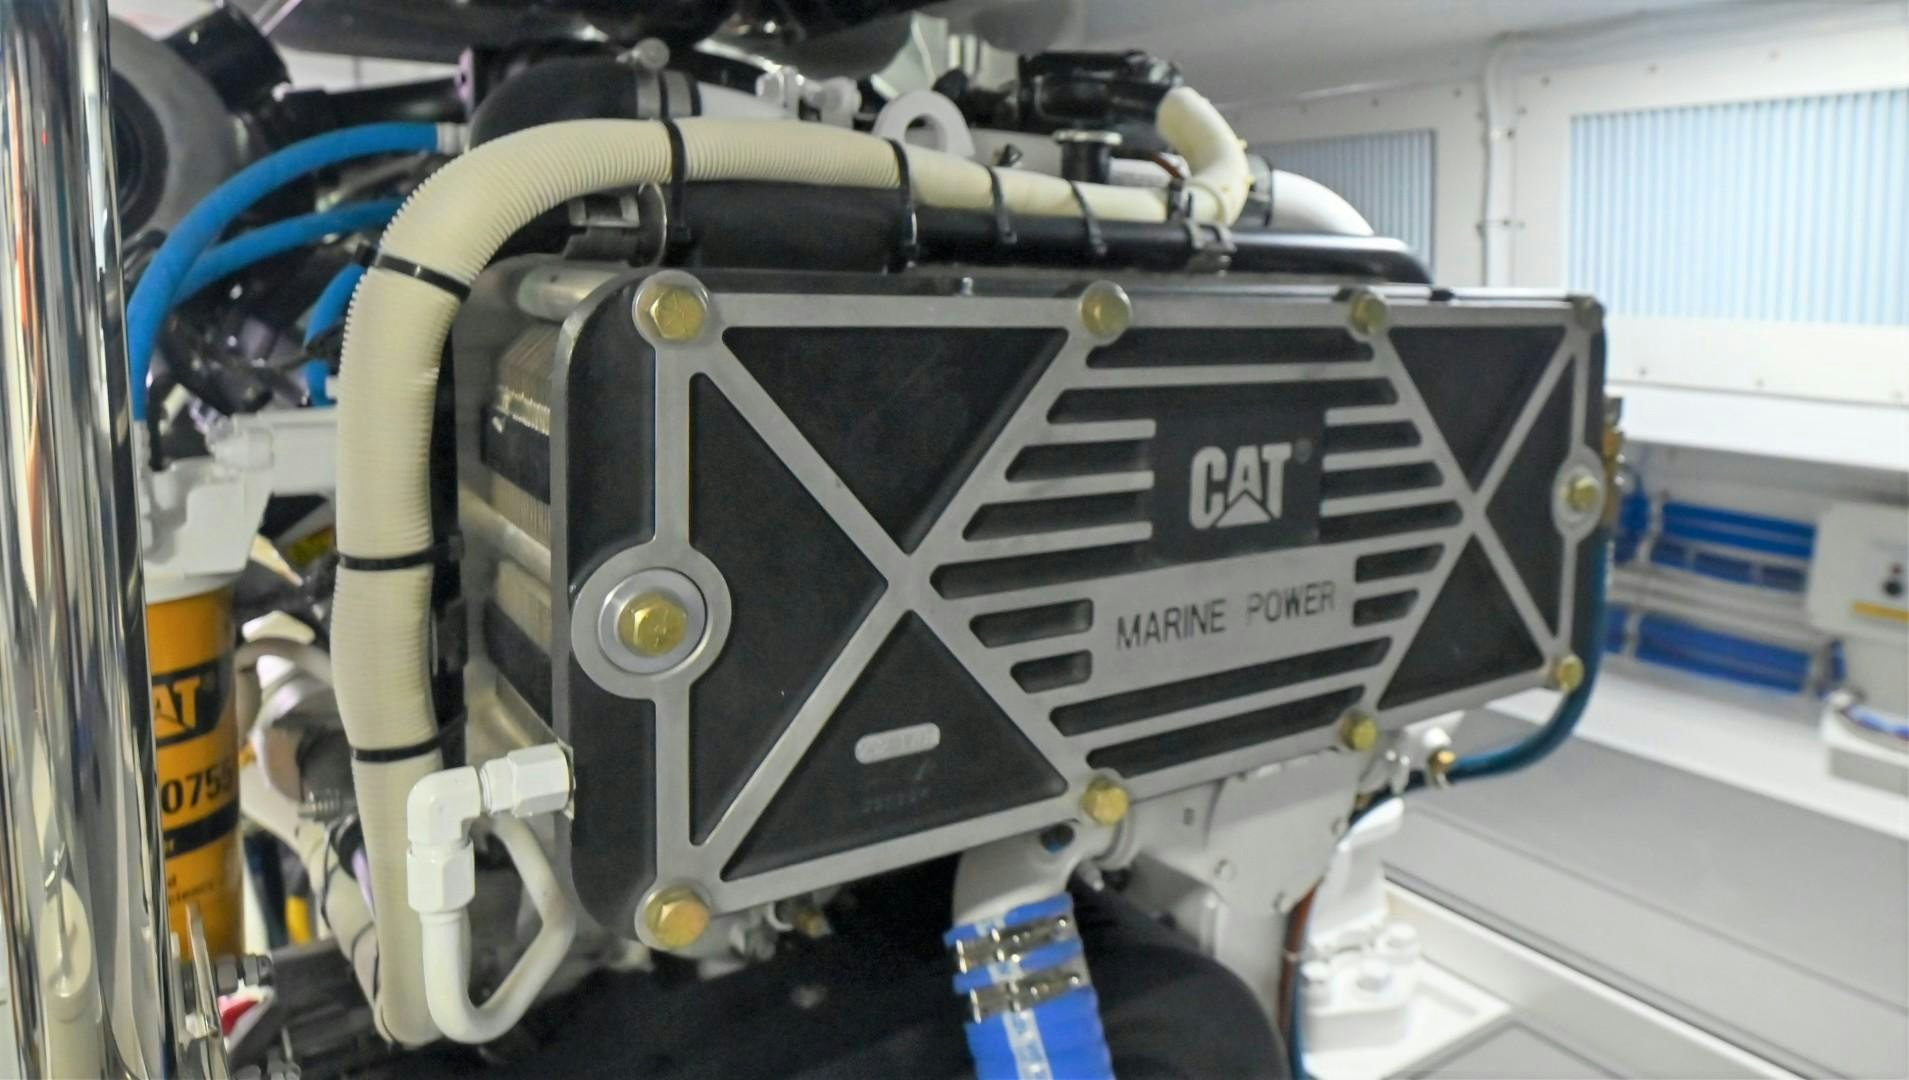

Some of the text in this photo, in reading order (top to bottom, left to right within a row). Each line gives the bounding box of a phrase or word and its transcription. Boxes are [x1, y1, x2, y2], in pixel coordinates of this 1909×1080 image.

[1190, 443, 1293, 530] CAT
[1117, 581, 1335, 649] MARINE POWER
[152, 675, 200, 733] AT
